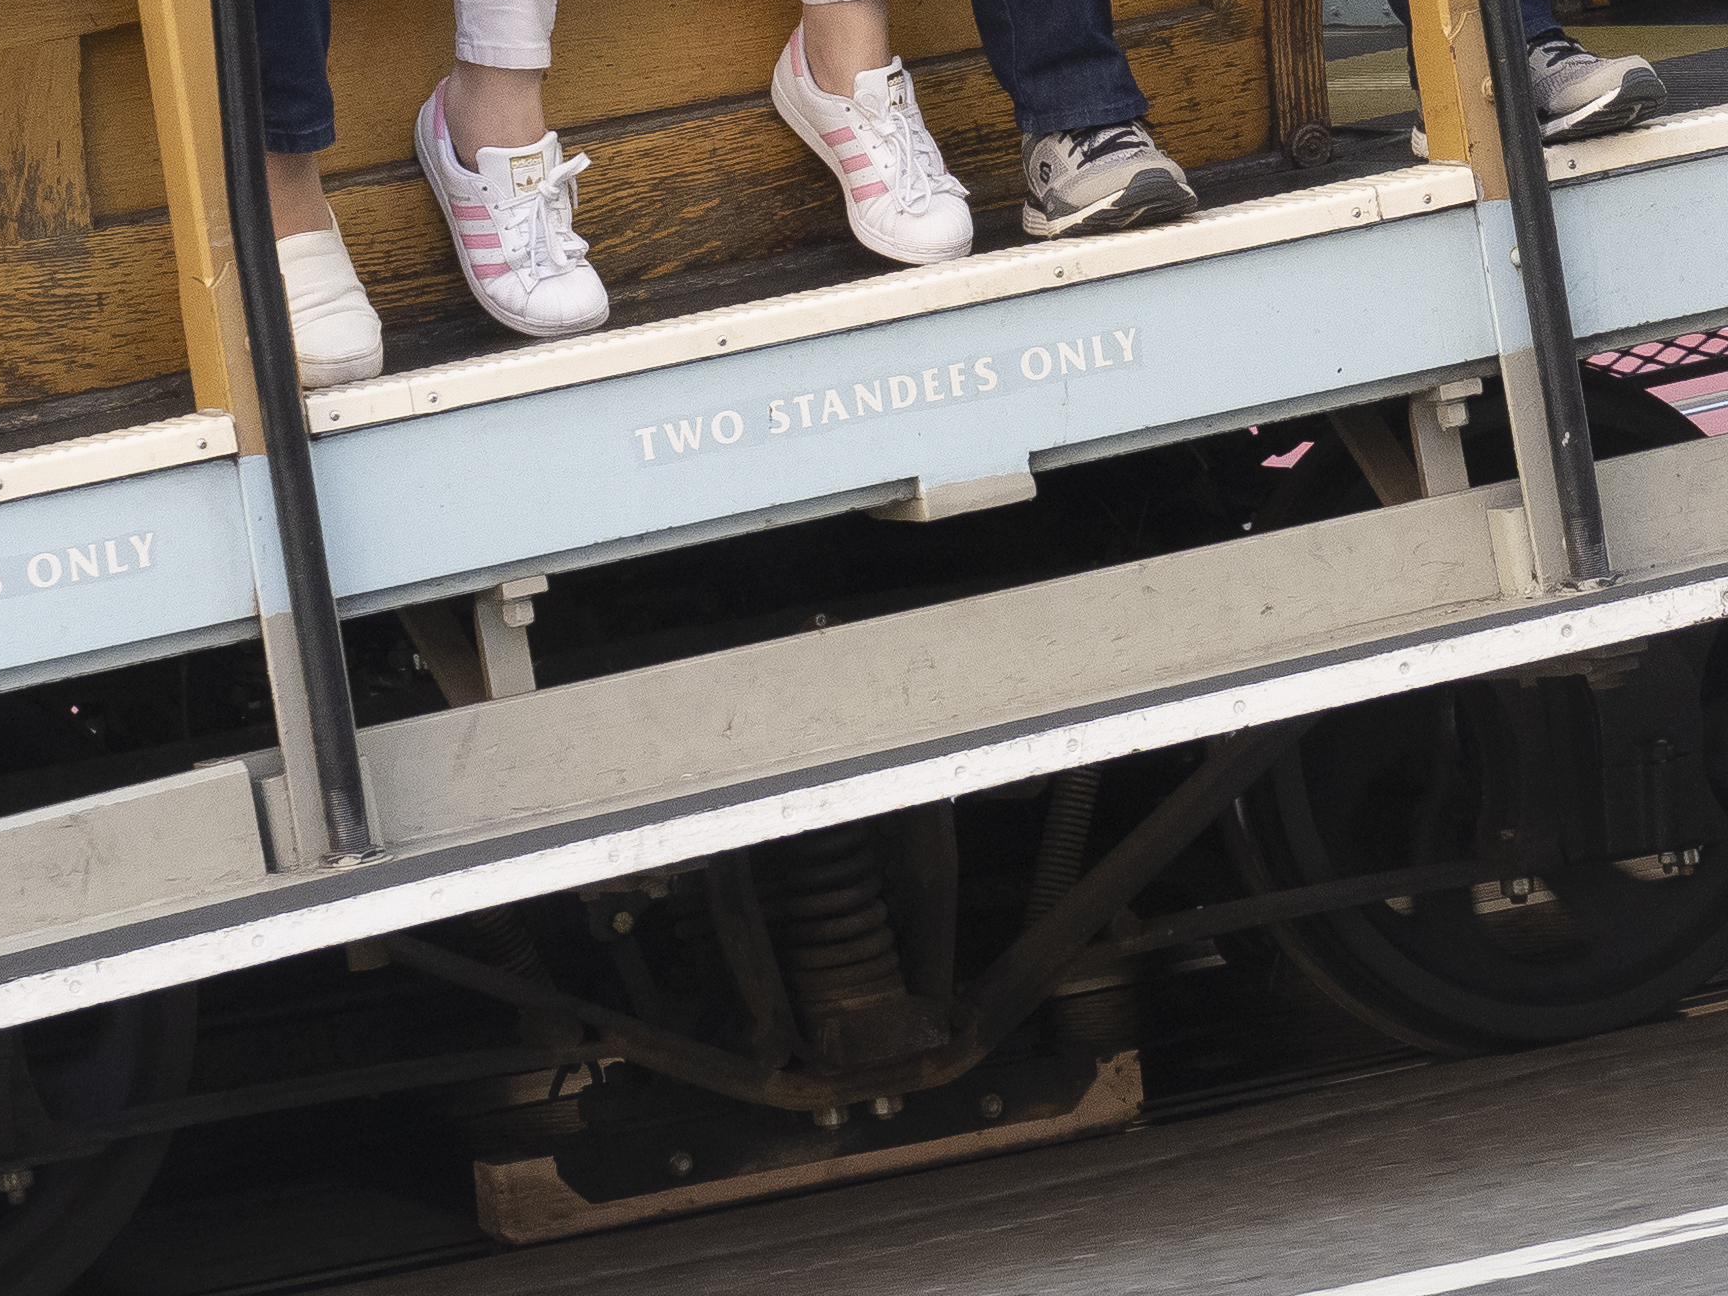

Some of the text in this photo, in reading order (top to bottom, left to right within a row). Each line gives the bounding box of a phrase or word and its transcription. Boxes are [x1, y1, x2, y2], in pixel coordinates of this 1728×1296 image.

[634, 408, 745, 462] TWO
[1019, 326, 1138, 381] ONLY
[26, 531, 156, 591] ONLY
